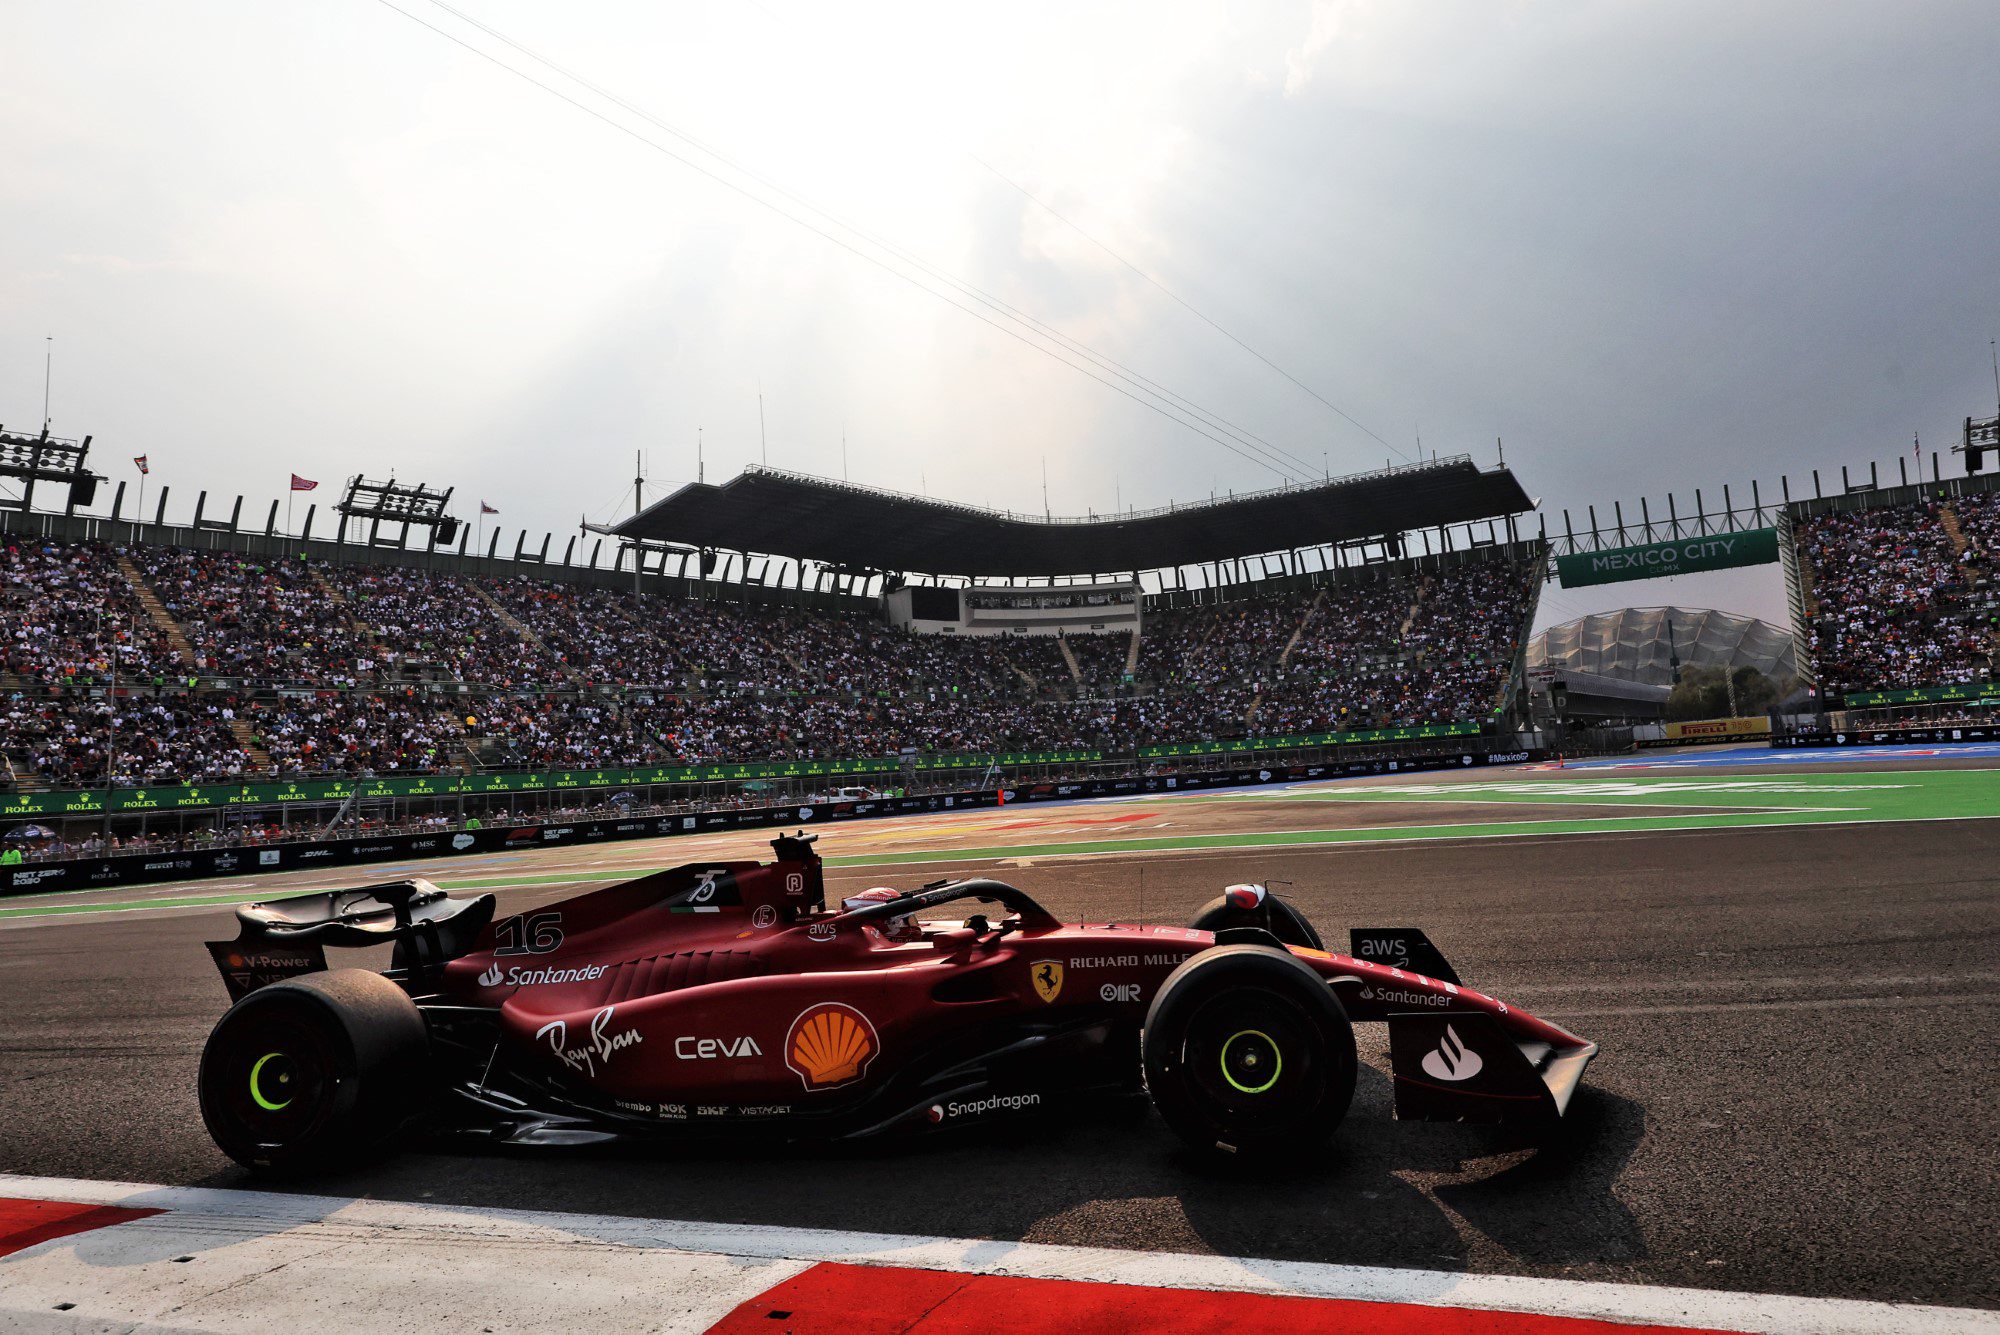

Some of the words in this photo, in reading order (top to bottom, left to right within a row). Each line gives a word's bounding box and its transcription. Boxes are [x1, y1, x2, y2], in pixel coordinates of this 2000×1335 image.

[1592, 547, 1677, 573] MEXICO
[1684, 539, 1736, 560] CITY
[1681, 722, 1727, 734] PIRELLI
[1488, 752, 1529, 763] #MexicoGP
[124, 800, 157, 808] ROLEX
[178, 797, 210, 805] ROLEX
[5, 805, 43, 814] ROLEX
[67, 803, 101, 811] ROLEX
[361, 845, 393, 853] crypto.com
[419, 840, 436, 848] MSC
[91, 872, 120, 880] ROLEX
[928, 887, 967, 902] Snapdragon
[493, 911, 564, 957] 16
[809, 923, 836, 934] aws
[1361, 939, 1406, 956] aws
[244, 955, 311, 968] V-Power
[1070, 955, 1139, 969] RICHARD
[505, 964, 609, 986] Santander
[1376, 987, 1452, 1007] Santander
[615, 1099, 652, 1112] brembo
[659, 1103, 687, 1114] NGK
[948, 1093, 1040, 1117] Snapdragon
[697, 1106, 729, 1116] SKF
